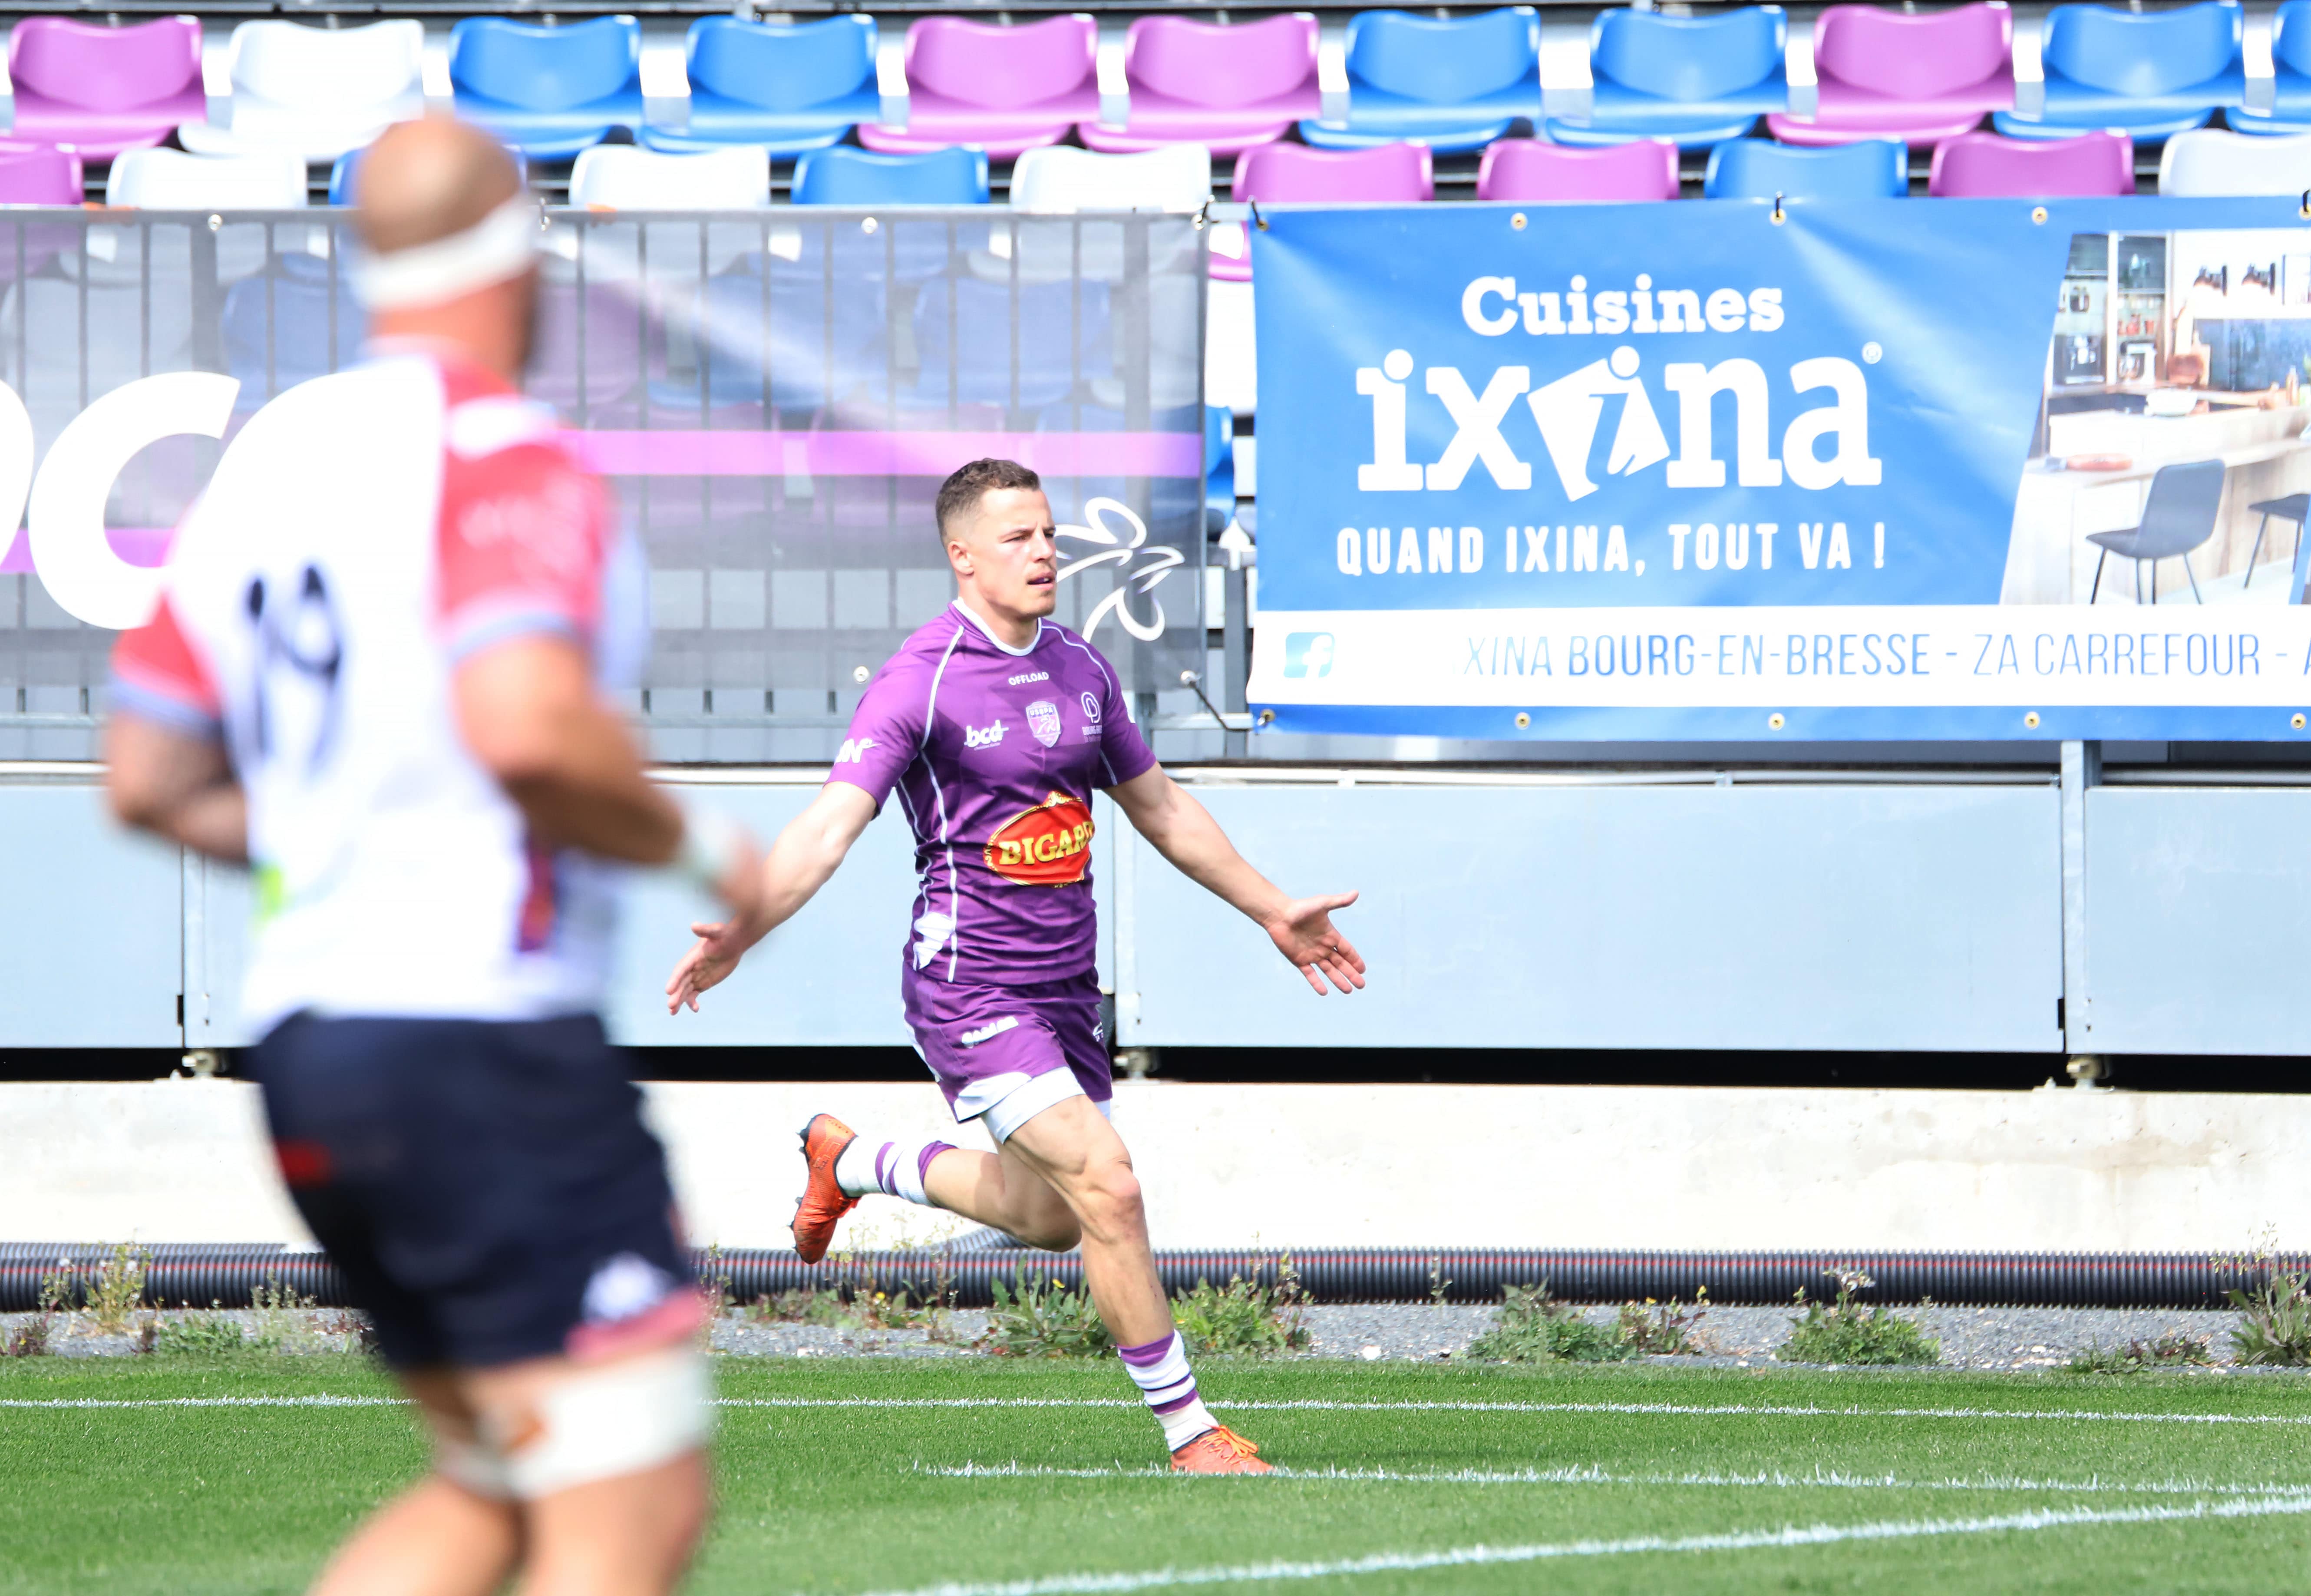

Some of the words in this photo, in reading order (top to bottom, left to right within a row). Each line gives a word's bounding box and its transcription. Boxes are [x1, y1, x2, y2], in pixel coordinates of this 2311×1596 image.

[1462, 274, 1784, 336] Cuisines
[1356, 346, 1882, 502] ixina
[1337, 526, 1484, 576] QUAND
[1505, 525, 1646, 577] IXINA,
[1667, 522, 1779, 571] TOUT
[1799, 522, 1851, 570] VA
[1874, 522, 1885, 569] !
[1008, 671, 1050, 686] OFFLOAD
[1568, 633, 1930, 677] BOURG-EN-BRESSE
[1973, 634, 2019, 676] ZA
[2034, 633, 2259, 676] CARREFOUR
[964, 719, 1009, 747] bcd
